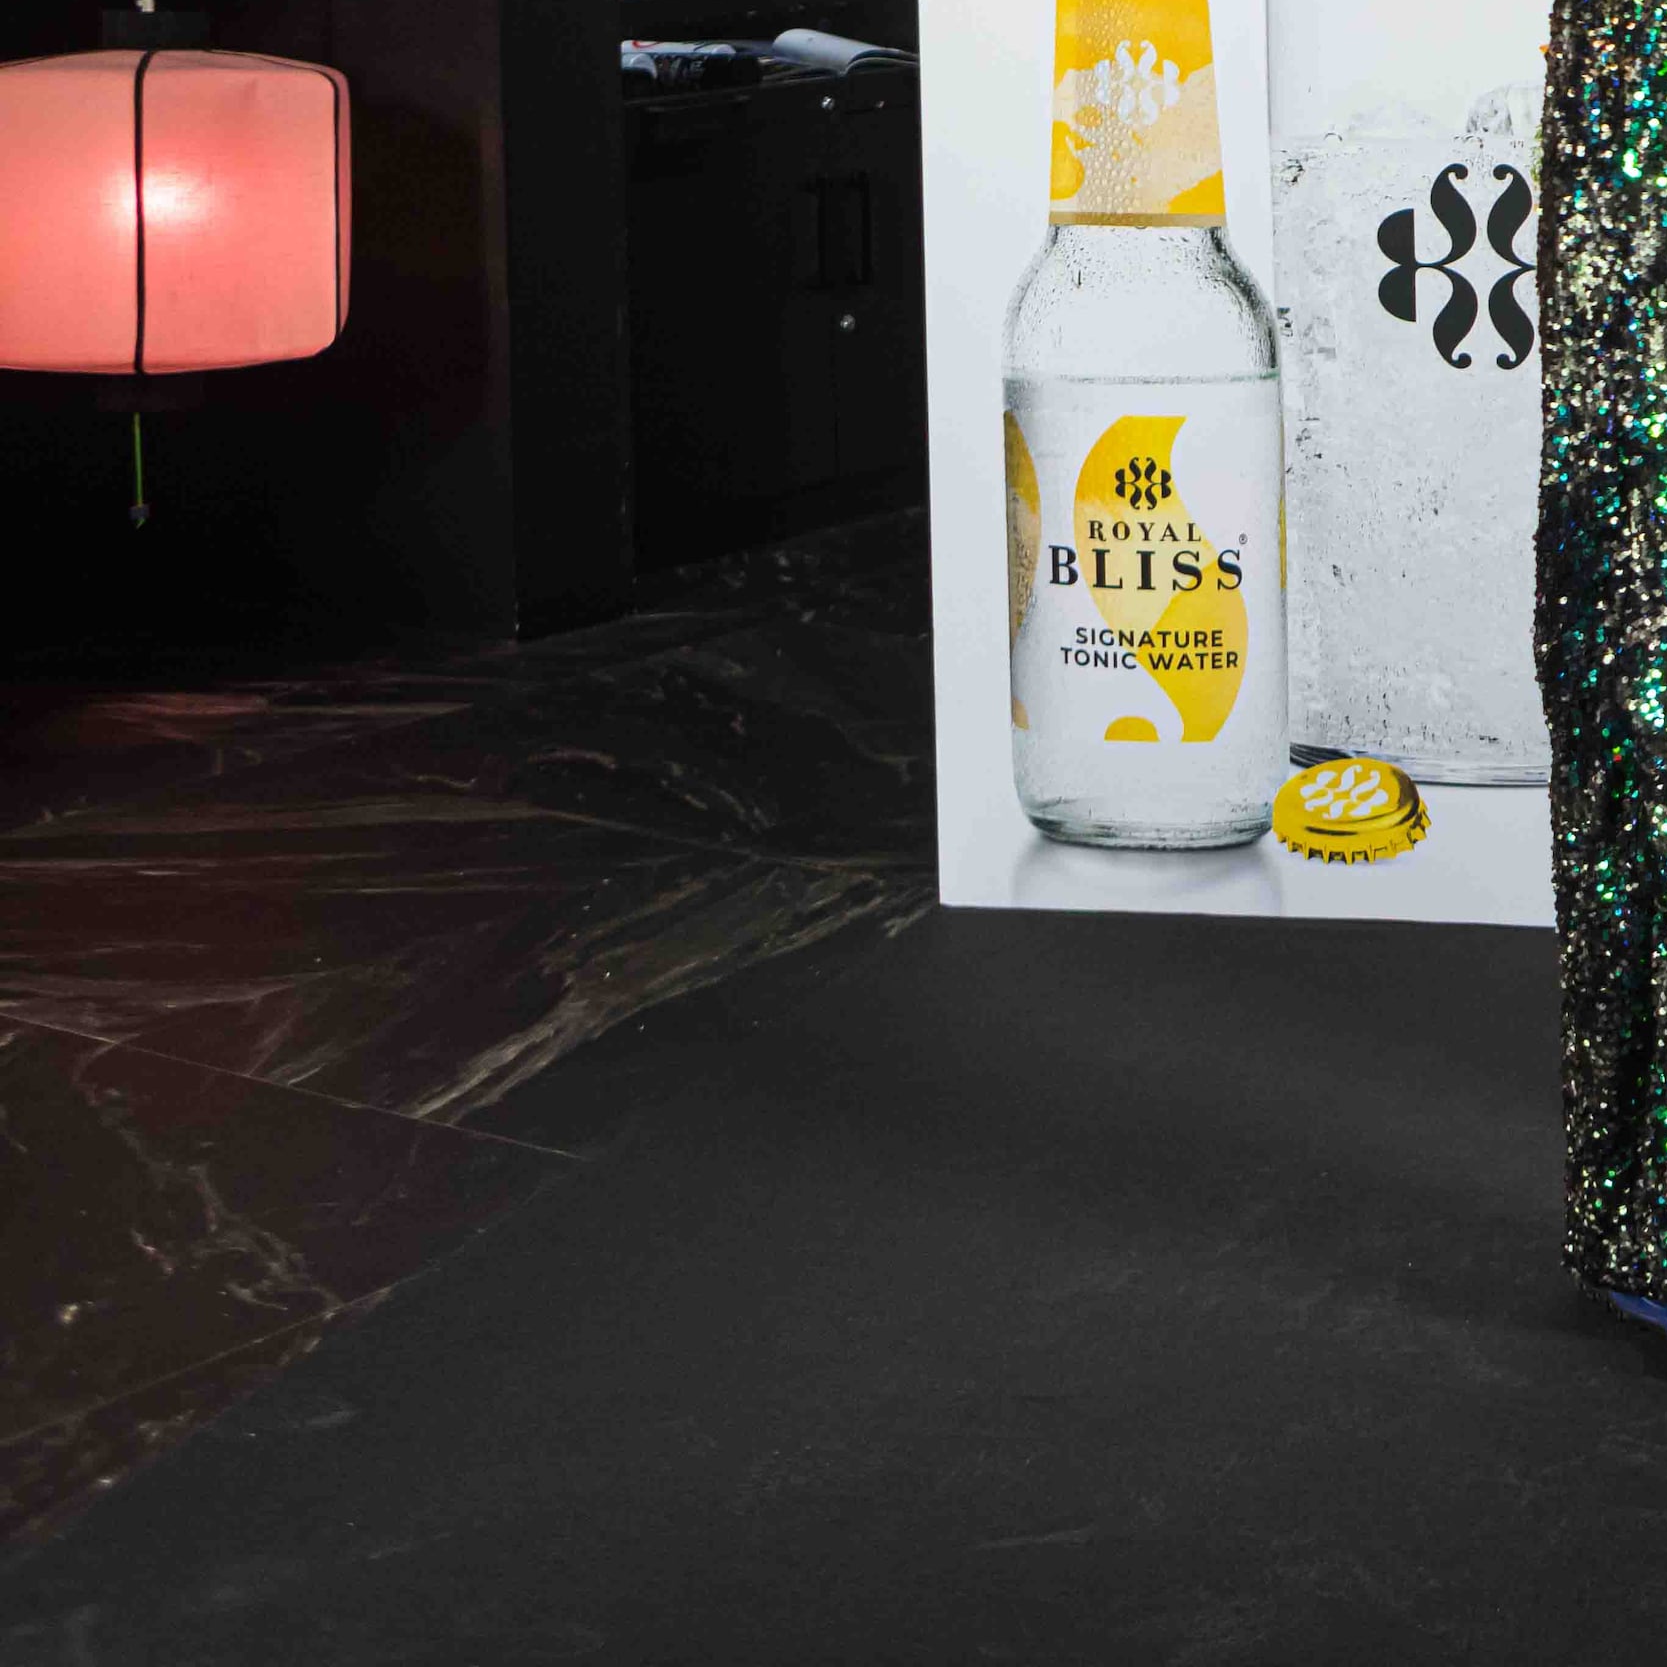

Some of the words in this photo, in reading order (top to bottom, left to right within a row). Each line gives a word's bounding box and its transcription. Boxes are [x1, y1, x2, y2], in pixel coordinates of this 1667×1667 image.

[1088, 519, 1202, 542] ROYAL
[1075, 626, 1224, 649] SIGNATURE
[1060, 646, 1137, 669] TONIC
[1148, 651, 1239, 671] WATER
